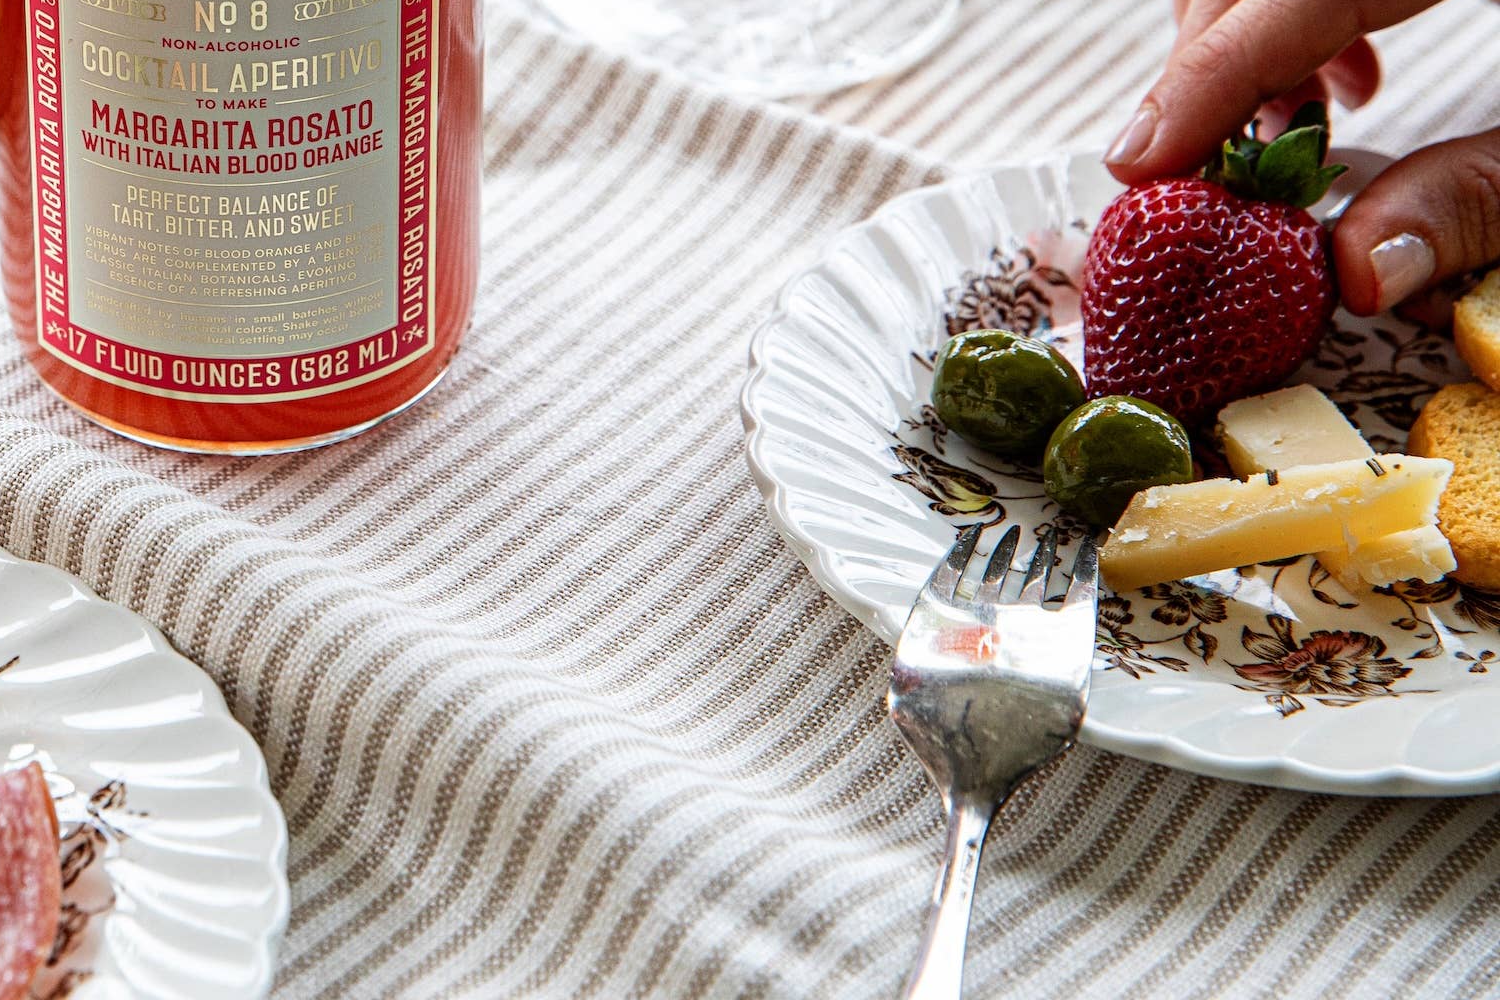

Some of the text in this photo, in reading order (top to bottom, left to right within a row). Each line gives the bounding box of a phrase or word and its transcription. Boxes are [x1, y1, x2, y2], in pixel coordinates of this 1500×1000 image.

[250, 0, 268, 31] 8
[162, 37, 301, 53] NON-ALCOHOLIC
[82, 39, 382, 93] COCKTAIL APERITIVO
[195, 98, 268, 110] TO MAKE
[91, 98, 374, 150] MARGARITA ROSATO
[35, 9, 66, 317] THE MARGARITA ROSATO
[81, 129, 384, 175] WITH ITALIAN BLOOD ORANGE
[402, 8, 428, 323] THE MARGARITA ROSATO
[127, 185, 339, 216] PERFECT BALANCE OF
[244, 217, 285, 238] AND
[290, 203, 356, 234] SWEET
[84, 223, 134, 247] VIBRANT
[138, 240, 180, 255] NOTES
[183, 247, 201, 257] OF
[205, 249, 251, 259] BLOOD
[255, 243, 311, 258] ORANGE
[315, 237, 342, 251] AND
[85, 237, 126, 258] CITRUS
[133, 252, 157, 265] ARE
[164, 259, 276, 272] COMPLEMENTED
[284, 258, 300, 269] BY
[307, 256, 316, 266] A
[323, 244, 362, 262] BLEND
[85, 249, 135, 273] CLASSIC
[142, 267, 193, 282] ITALIAN
[298, 259, 356, 280] EVOKING
[109, 270, 357, 298] ESSENCE OF A REFRESHING APERITIVO
[158, 310, 173, 321] by
[235, 315, 245, 324] in
[253, 312, 285, 324] small
[292, 304, 338, 320] batches
[282, 319, 319, 332] Shake
[323, 312, 346, 324] well
[240, 333, 285, 345] settling
[289, 331, 314, 342] may
[68, 327, 88, 355] 17
[95, 341, 163, 381] FLUID
[172, 360, 281, 388] OUNCES
[291, 349, 349, 384] (502
[358, 330, 399, 369] ML)
